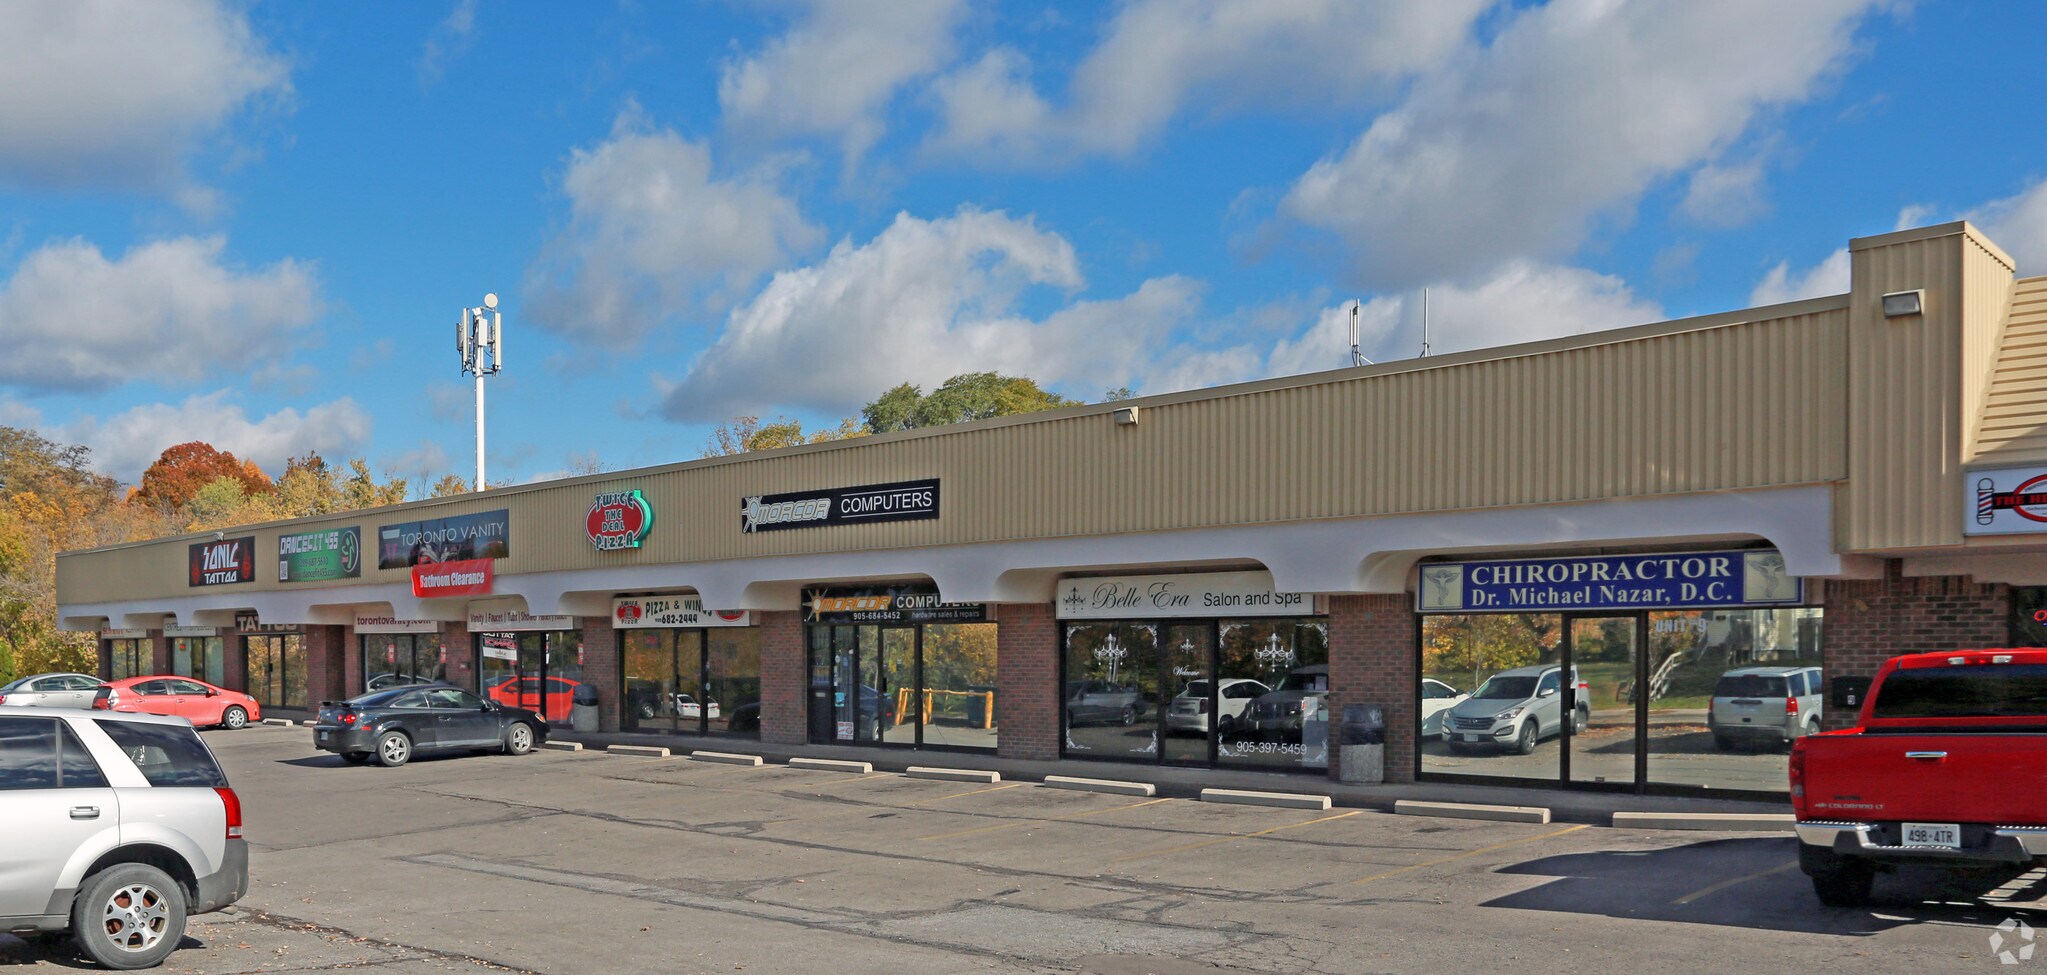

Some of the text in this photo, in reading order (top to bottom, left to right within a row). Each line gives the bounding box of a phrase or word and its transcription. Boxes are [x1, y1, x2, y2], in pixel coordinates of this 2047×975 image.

[595, 490, 634, 512] TWICE
[757, 491, 933, 524] MORCOR COMPUTERS
[605, 509, 622, 521] THE
[401, 522, 504, 546] TORONTO VANITY
[602, 521, 625, 532] DEAL
[595, 531, 634, 550] PIZZA
[203, 543, 239, 570] SONIC
[204, 571, 237, 584] TATTOO
[420, 572, 485, 588] Bathroom Clearance
[1471, 557, 1731, 585] CHIROPRACTOR
[1092, 581, 1302, 610] Belle Era Salon and Spa
[1472, 581, 1733, 606] Dr. Michael Nazar, D.C.
[646, 600, 670, 619] PIZZA
[674, 600, 680, 609] &
[821, 595, 893, 612] MORCOR
[853, 611, 901, 620] 905-684-5452
[1656, 619, 1686, 633] UNIT
[1236, 741, 1308, 755] 905-397-5459
